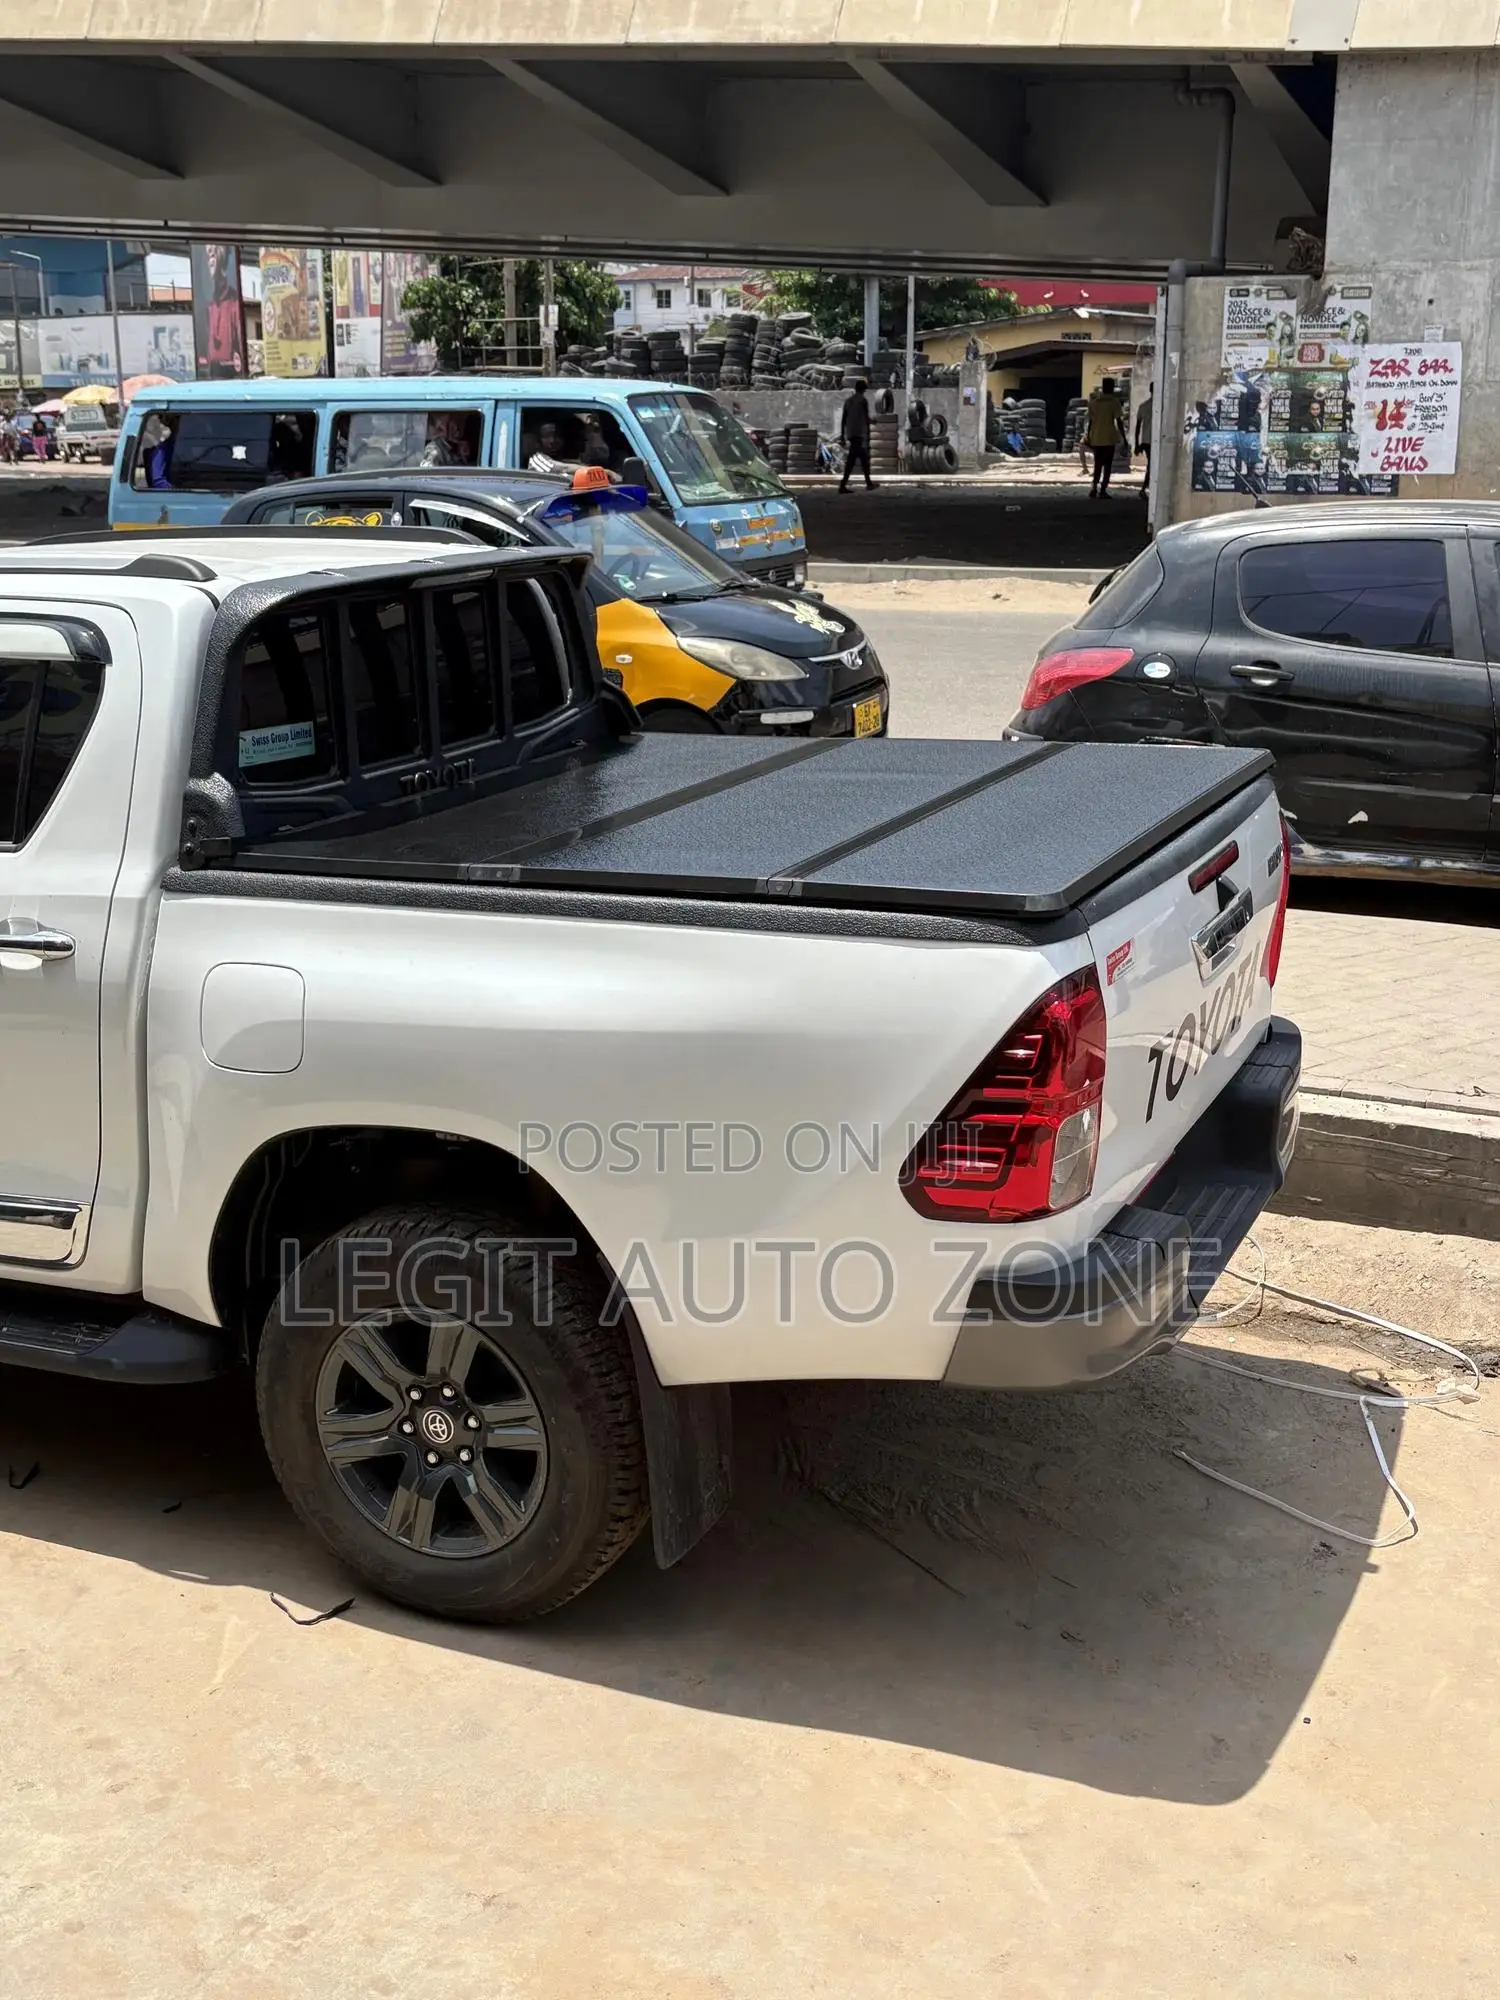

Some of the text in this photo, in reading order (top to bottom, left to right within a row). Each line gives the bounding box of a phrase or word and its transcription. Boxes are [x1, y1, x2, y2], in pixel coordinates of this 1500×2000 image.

[1228, 307, 1271, 316] WASSCE &
[1337, 306, 1346, 315] &
[1228, 315, 1264, 324] NOVDEC
[1300, 313, 1338, 323] NOVDEC
[1384, 436, 1425, 453] LIVE
[587, 469, 605, 481] TAXI
[251, 725, 313, 747] Swiss Group Limited
[1145, 942, 1260, 1124] TOYOTA
